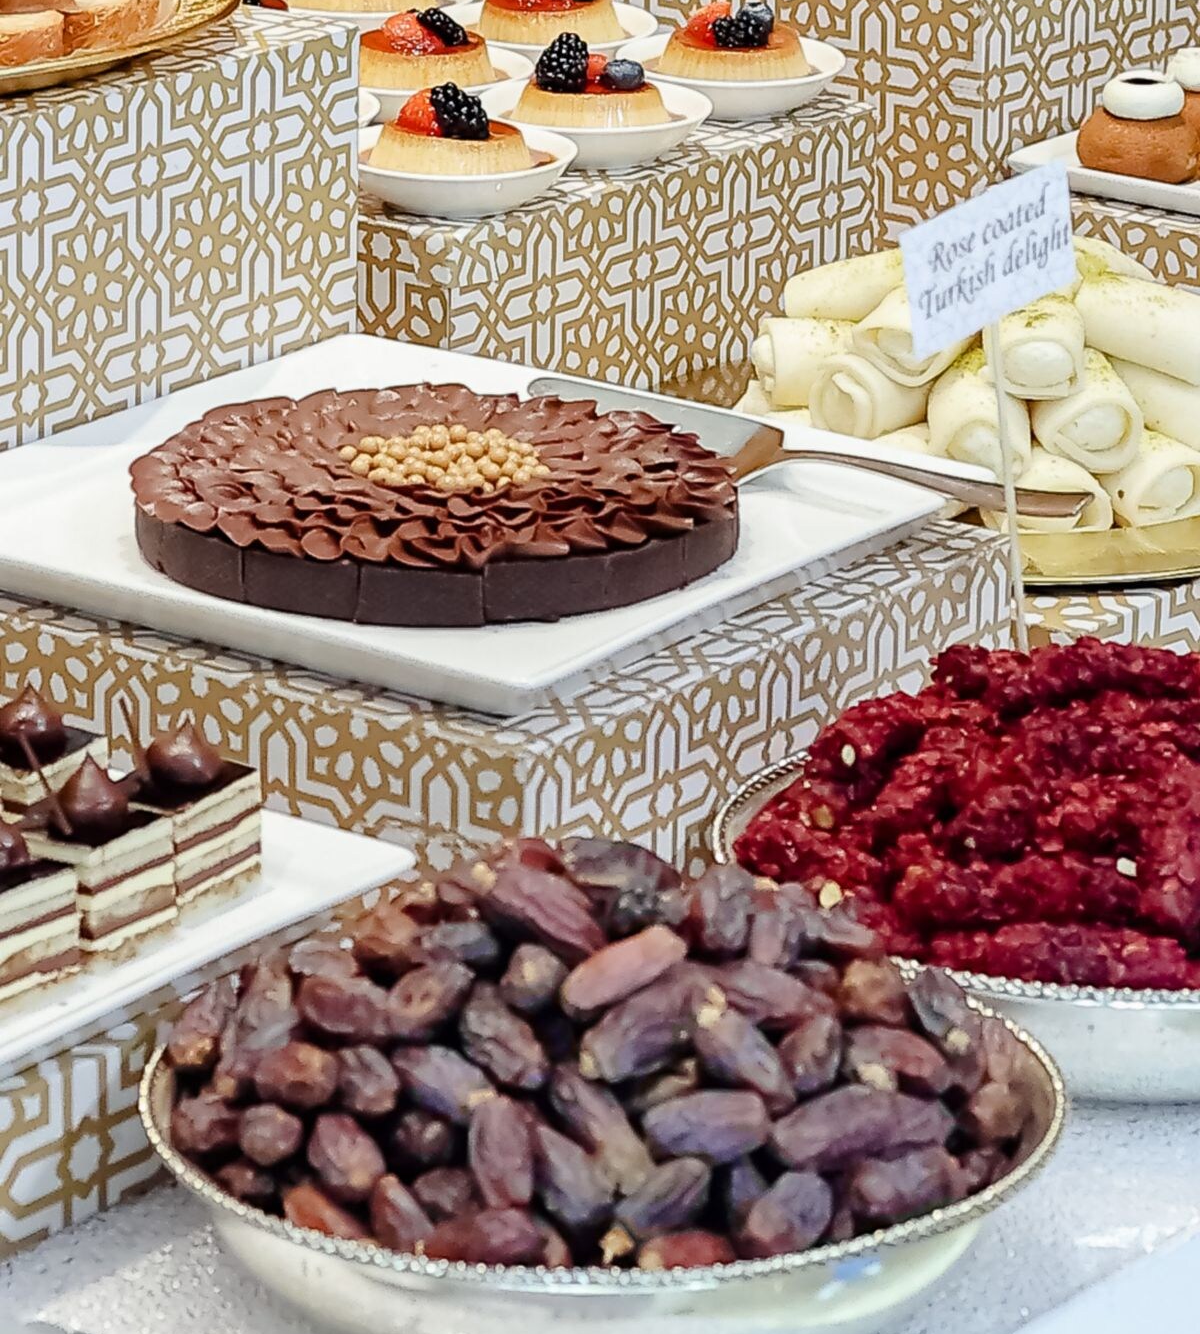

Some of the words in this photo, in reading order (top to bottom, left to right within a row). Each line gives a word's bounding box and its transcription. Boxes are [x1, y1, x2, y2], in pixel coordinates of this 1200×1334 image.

[918, 251, 996, 319] Turkish
[1002, 217, 1069, 277] delight
[927, 230, 976, 273] Rose
[982, 181, 1050, 246] coated
